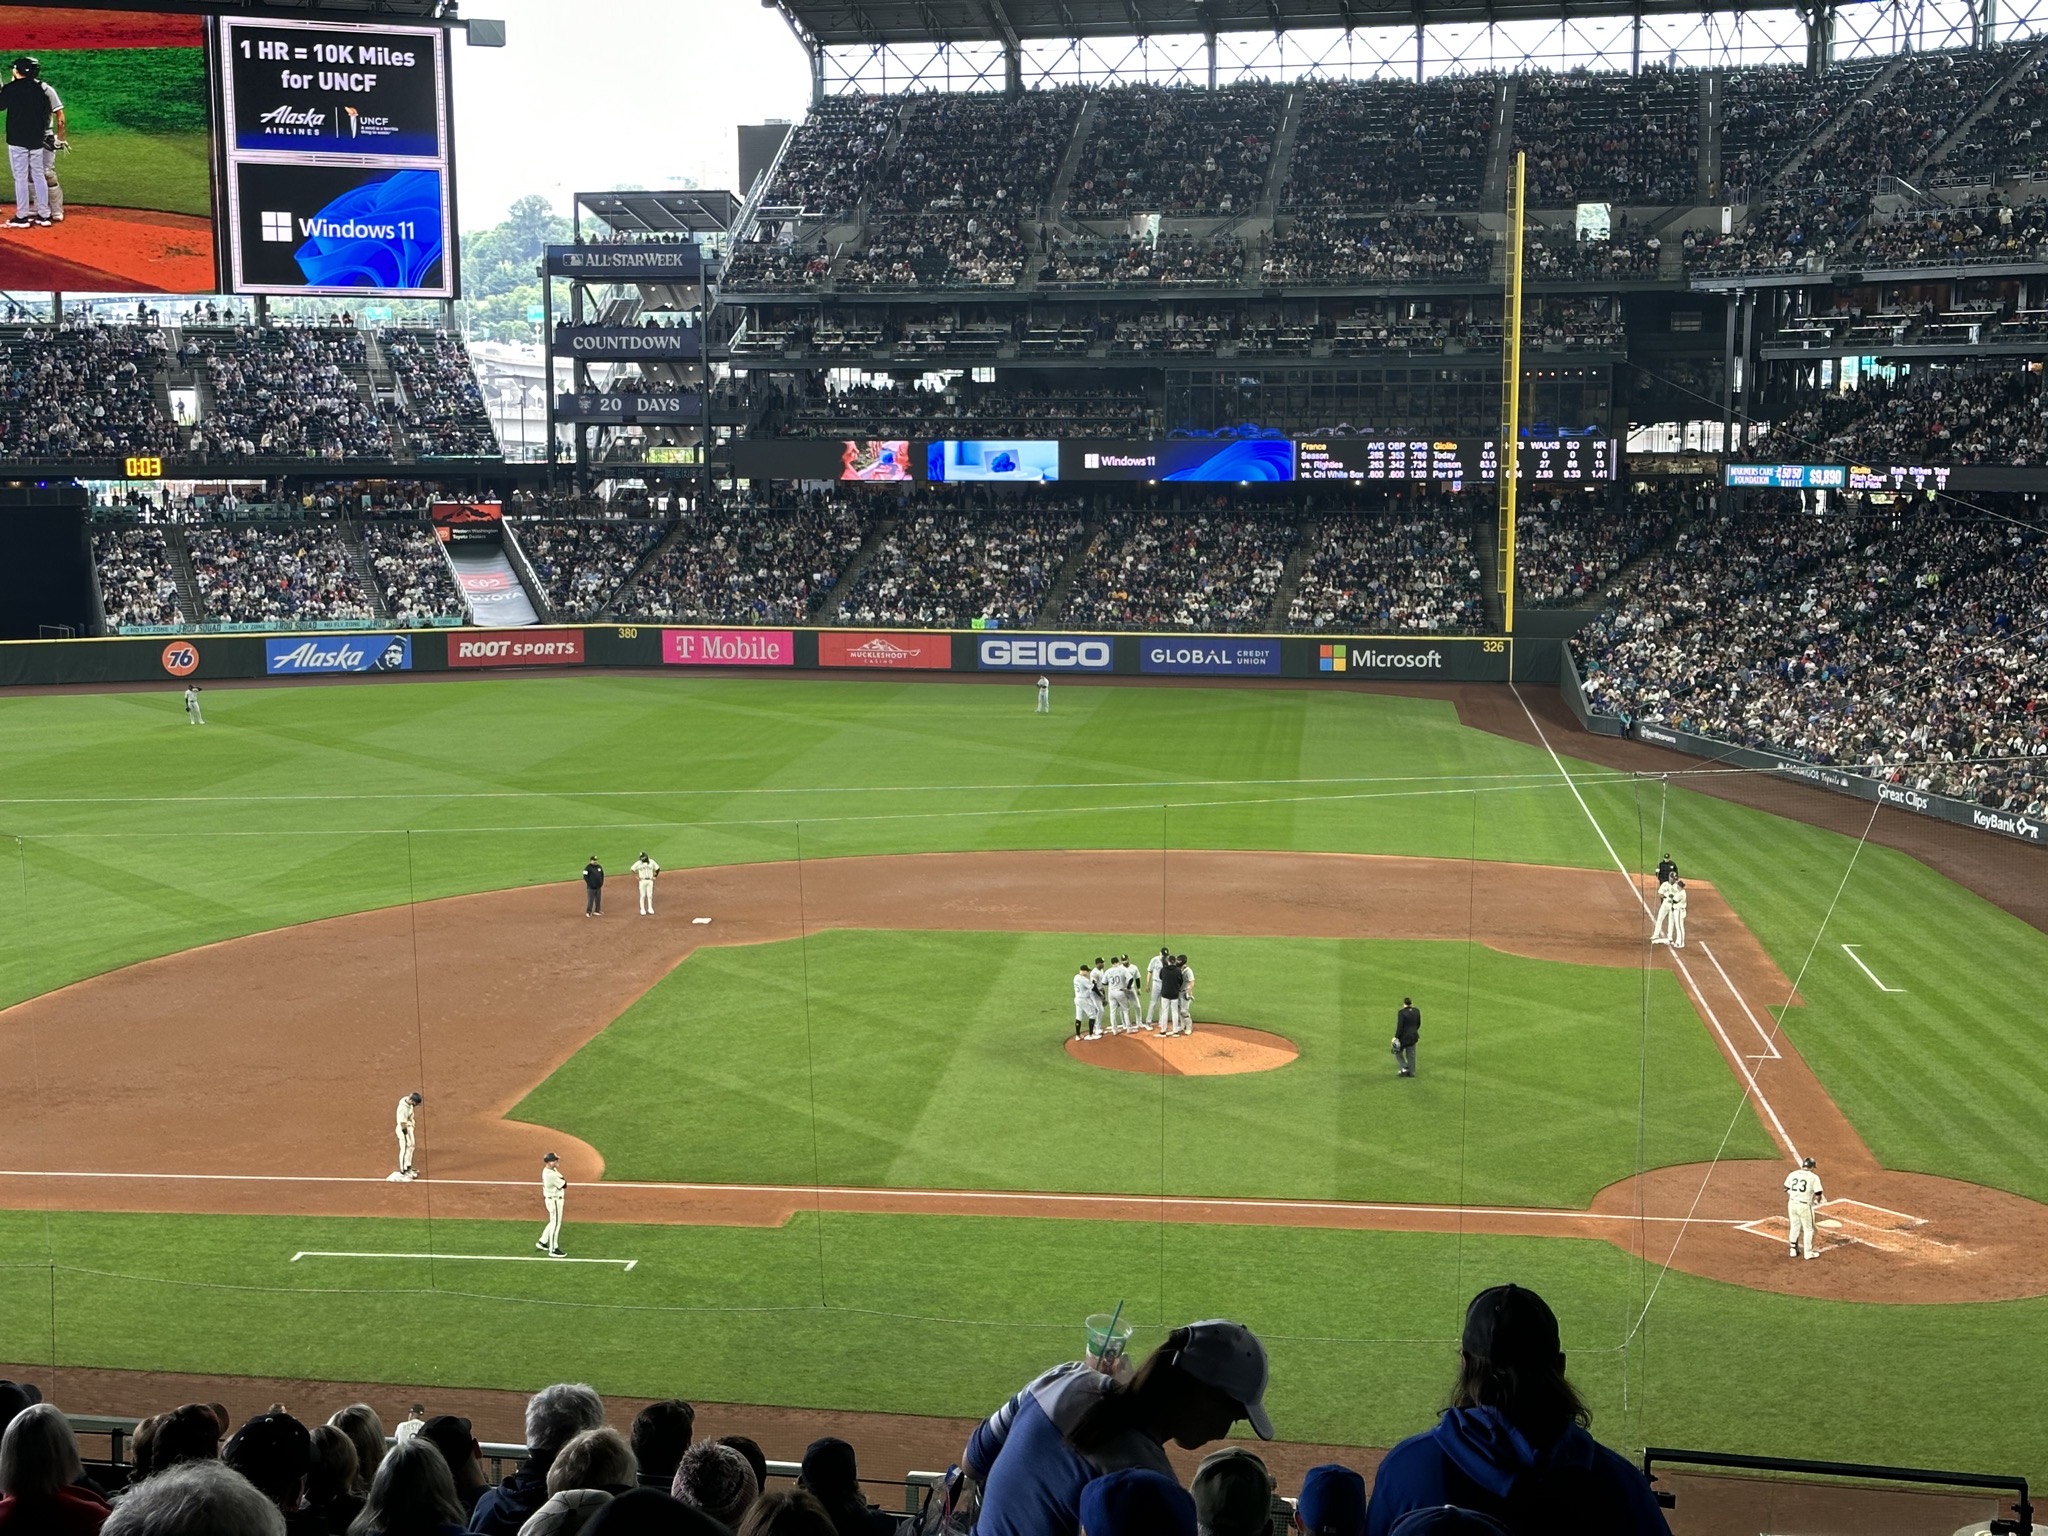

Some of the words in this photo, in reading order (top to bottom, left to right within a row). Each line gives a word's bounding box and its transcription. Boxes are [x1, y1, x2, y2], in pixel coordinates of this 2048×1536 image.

[240, 40, 251, 59] 1
[258, 40, 289, 61] HR
[313, 44, 354, 64] 10K
[359, 46, 415, 67] Miles
[281, 69, 314, 89] for
[318, 72, 377, 92] UNCF
[260, 105, 325, 127] Alaska
[360, 117, 389, 126] UNCF
[265, 127, 320, 136] AIRLINES
[298, 218, 395, 239] Windows
[398, 222, 414, 240] 11
[573, 336, 681, 350] COUNTDOWN
[600, 398, 622, 412] 20
[637, 398, 680, 412] DAYS
[1367, 442, 1385, 450] AVG
[1388, 442, 1406, 450] OBP
[1410, 442, 1428, 450] OPS
[1484, 442, 1493, 450] IP
[1530, 441, 1560, 449] WALKS
[1566, 441, 1580, 449] SO
[1593, 441, 1606, 449] HR
[1101, 456, 1146, 466] Windows
[1147, 456, 1156, 466] 11
[1301, 452, 1329, 460] Season
[1433, 451, 1456, 461] Today
[1482, 451, 1495, 459] 0.0
[1542, 451, 1548, 459] 0
[1569, 451, 1576, 459] 0
[1597, 451, 1603, 459] 0
[126, 457, 161, 476] 0:03
[1313, 461, 1343, 470] Righties
[1433, 460, 1462, 469] Season
[1540, 460, 1550, 468] 27
[1595, 460, 1604, 468] 13
[1433, 470, 1446, 478] Per
[1447, 470, 1453, 478] 9
[1454, 470, 1463, 478] IP
[1482, 470, 1495, 478] 9.0
[1591, 470, 1608, 478] 1.41
[1730, 467, 1758, 476] MARINERS
[1759, 468, 1774, 476] CARE
[1890, 467, 1907, 475] Balls
[1909, 467, 1932, 475] Strikes
[1934, 467, 1950, 475] Total
[1734, 476, 1769, 484] FOUNDATION
[1809, 469, 1842, 486] $9,890
[1867, 474, 1887, 482] Count
[199, 624, 221, 632] SQUAD
[618, 628, 637, 639] 380
[459, 641, 511, 658] ROOT
[512, 642, 575, 656] SPORTS
[701, 636, 779, 660] Mobile
[1483, 641, 1505, 653] 326
[167, 649, 193, 668] 76
[273, 642, 364, 670] Alaska
[850, 652, 907, 660] MUCKLESHOOT
[981, 640, 1110, 667] GEICO
[1150, 649, 1233, 664] GLOBAL
[1352, 650, 1442, 668] Microsoft
[1877, 783, 1904, 803] Great
[1905, 790, 1928, 811] Clips
[1974, 810, 2016, 833] KeyBank
[1110, 975, 1121, 985] 30
[1791, 1178, 1807, 1193] 23
